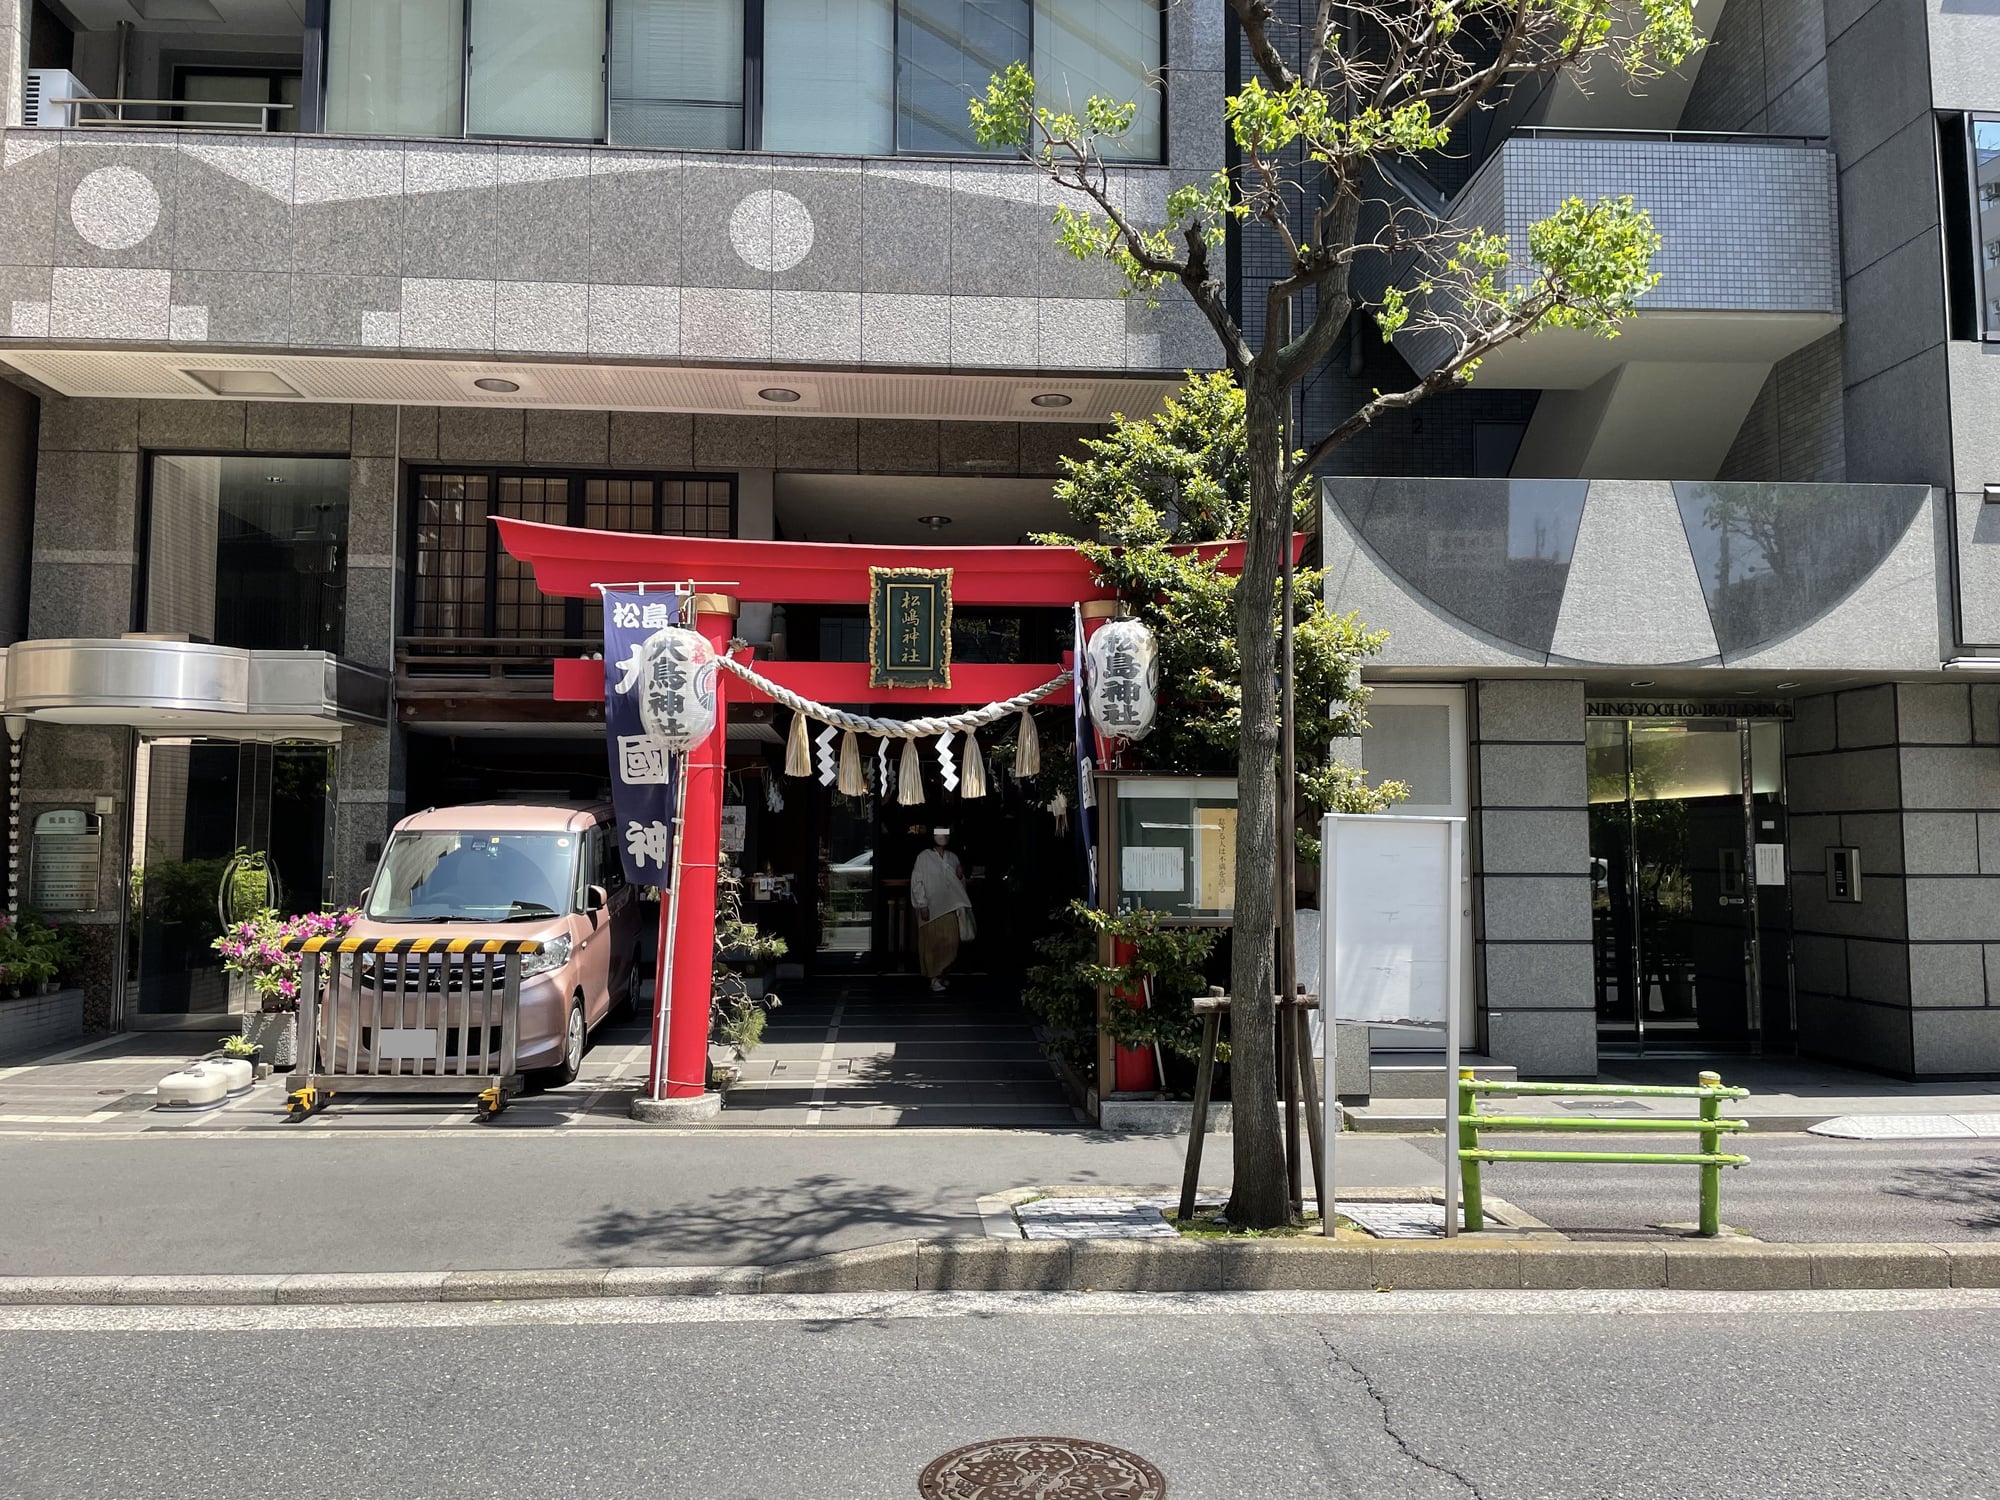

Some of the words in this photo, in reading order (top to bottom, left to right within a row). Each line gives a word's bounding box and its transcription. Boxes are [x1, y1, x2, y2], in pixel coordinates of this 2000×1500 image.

[613, 602, 669, 629] 松島
[901, 591, 921, 663] 松嶋神社
[647, 636, 691, 736] 大鳥神社
[1101, 628, 1145, 726] 松島神社
[1586, 703, 1696, 717] NINGYOCHO
[1703, 703, 1791, 717] BUILDING
